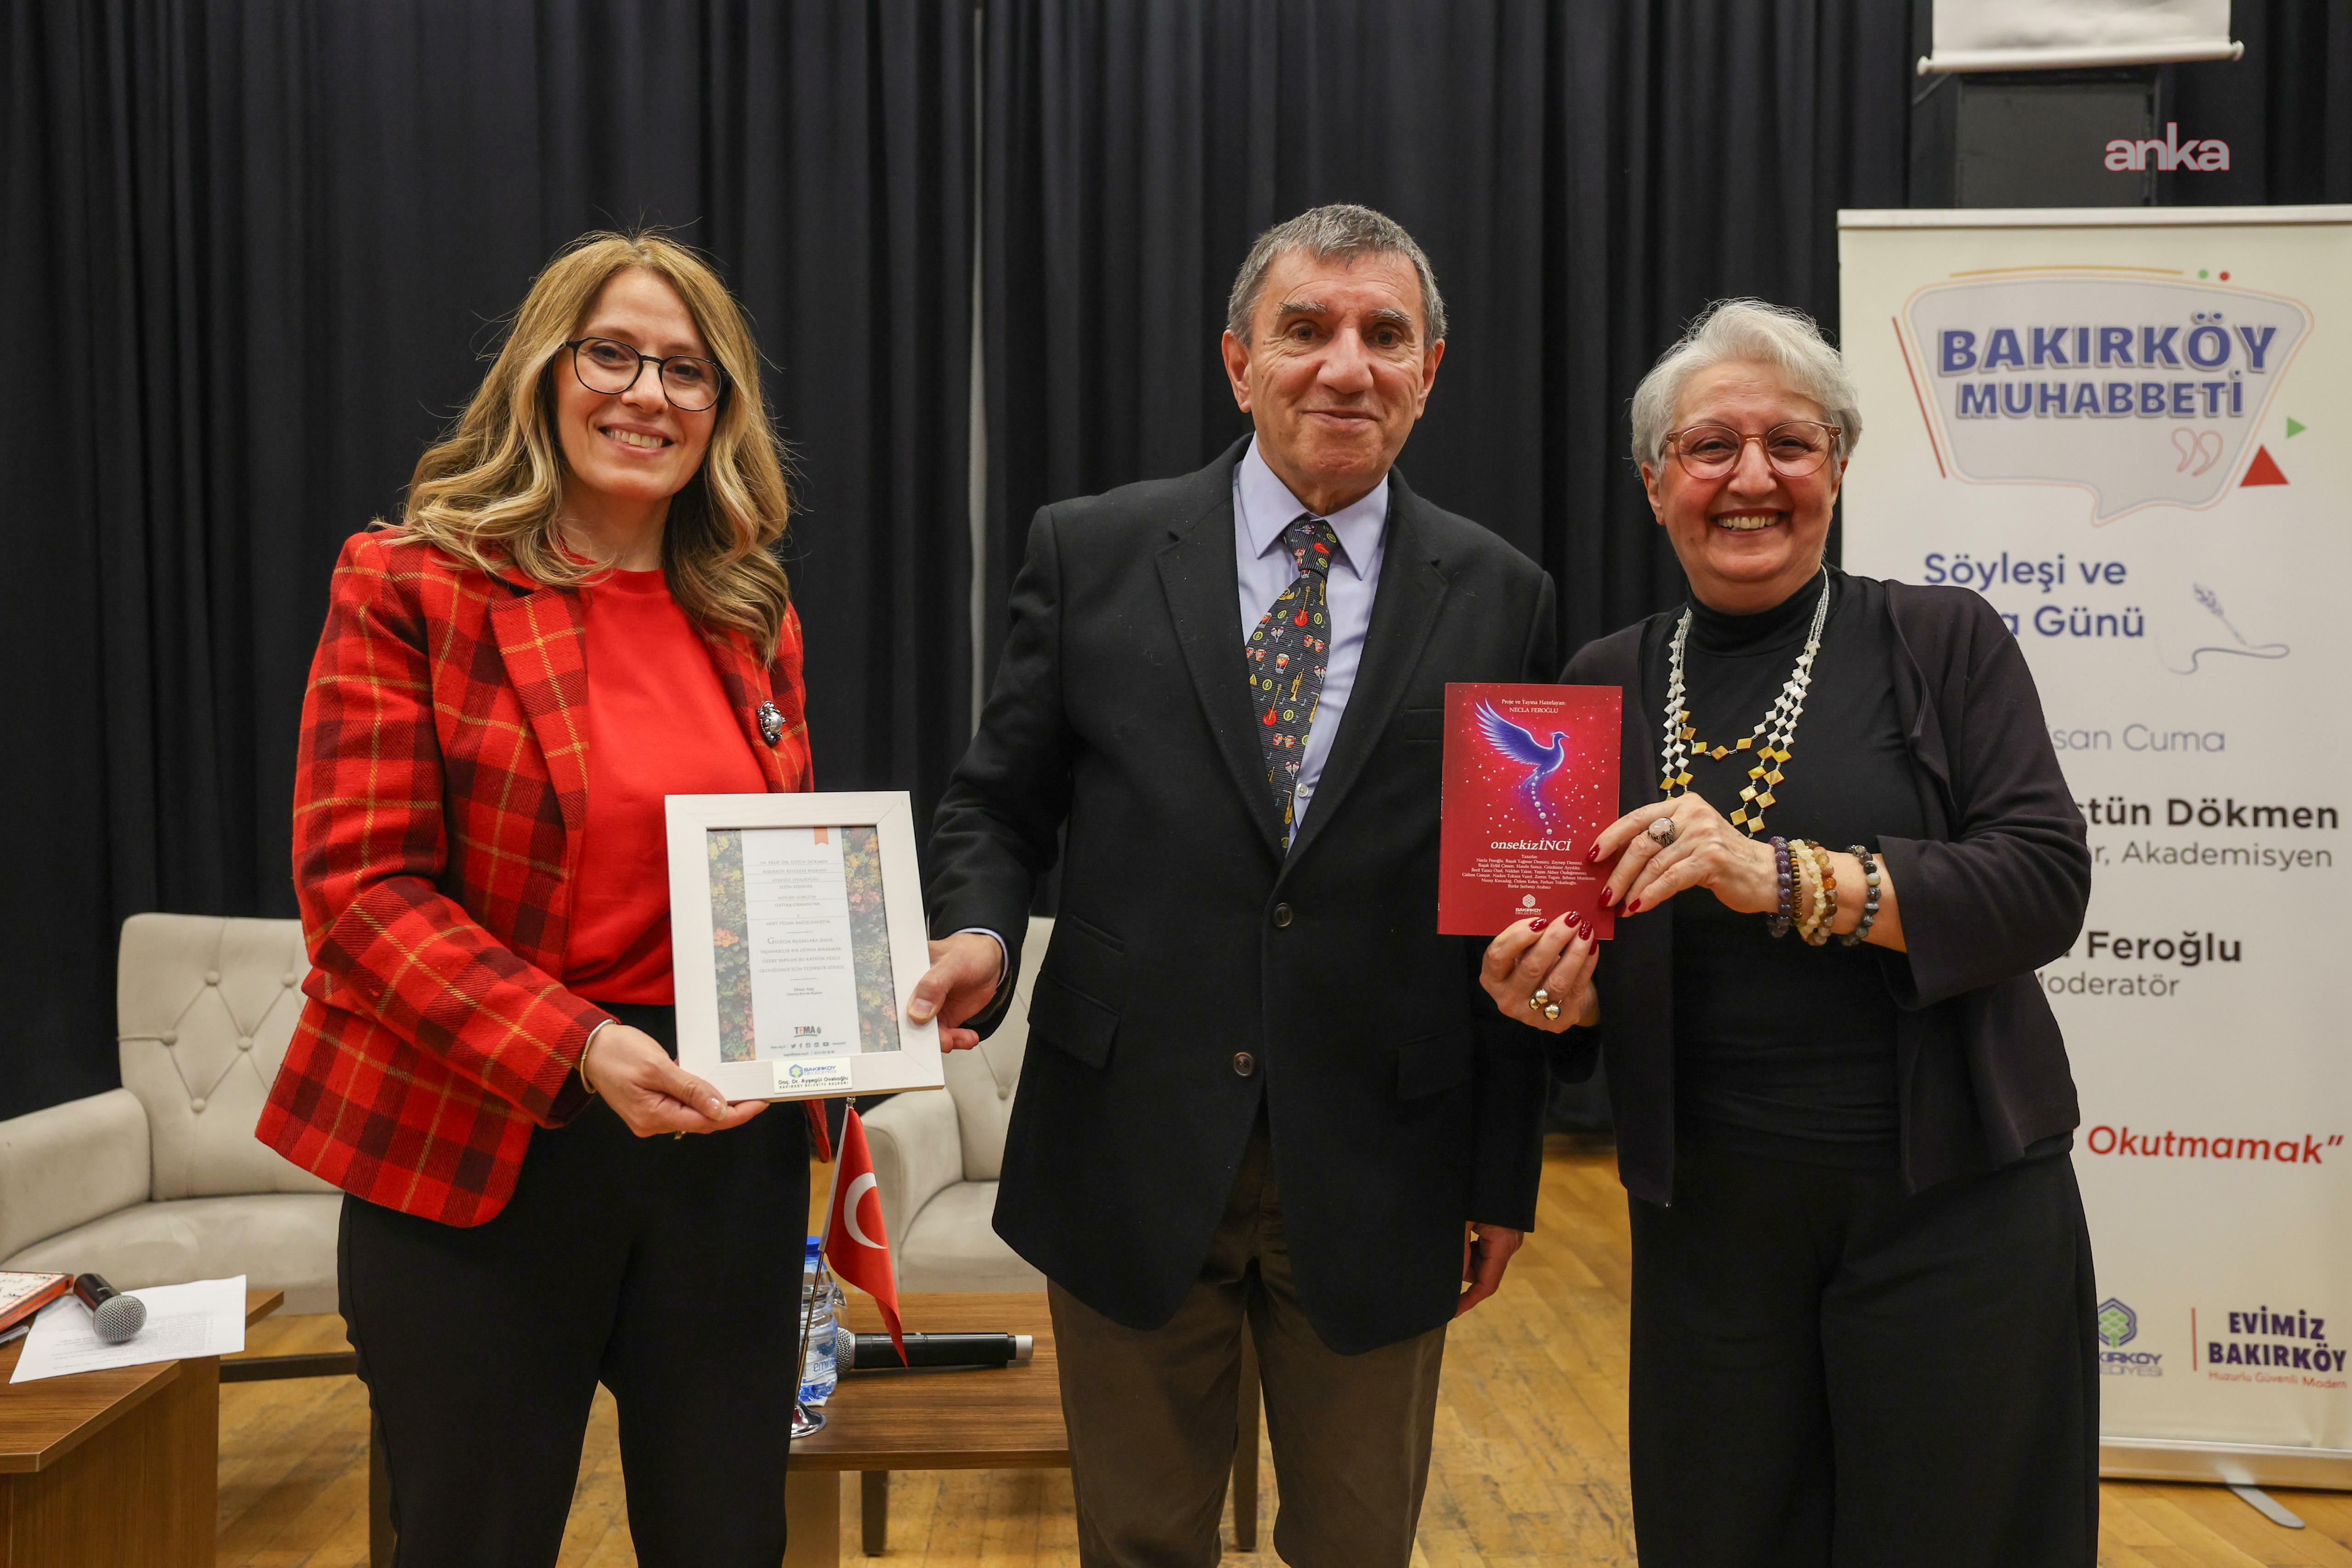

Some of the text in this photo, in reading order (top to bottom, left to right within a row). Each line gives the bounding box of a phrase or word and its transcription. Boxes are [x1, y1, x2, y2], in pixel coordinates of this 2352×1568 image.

[1942, 312, 2277, 373] BAKIRKÖY
[1958, 369, 2244, 416] MUHABBETİ
[1923, 552, 2127, 592] Söyleşi ve
[2034, 605, 2145, 638] Günü
[2122, 723, 2226, 752] Cuma
[2076, 796, 2339, 829] tün Dökmen
[1491, 838, 1572, 851] onsekizİNCİ
[2121, 841, 2332, 872] Akademisyen
[2087, 931, 2241, 966] Feroğlu
[794, 1025, 815, 1034] TEMA
[2229, 1306, 2325, 1341] EVİMİZ
[2208, 1342, 2347, 1372] BAKIRKÖY
